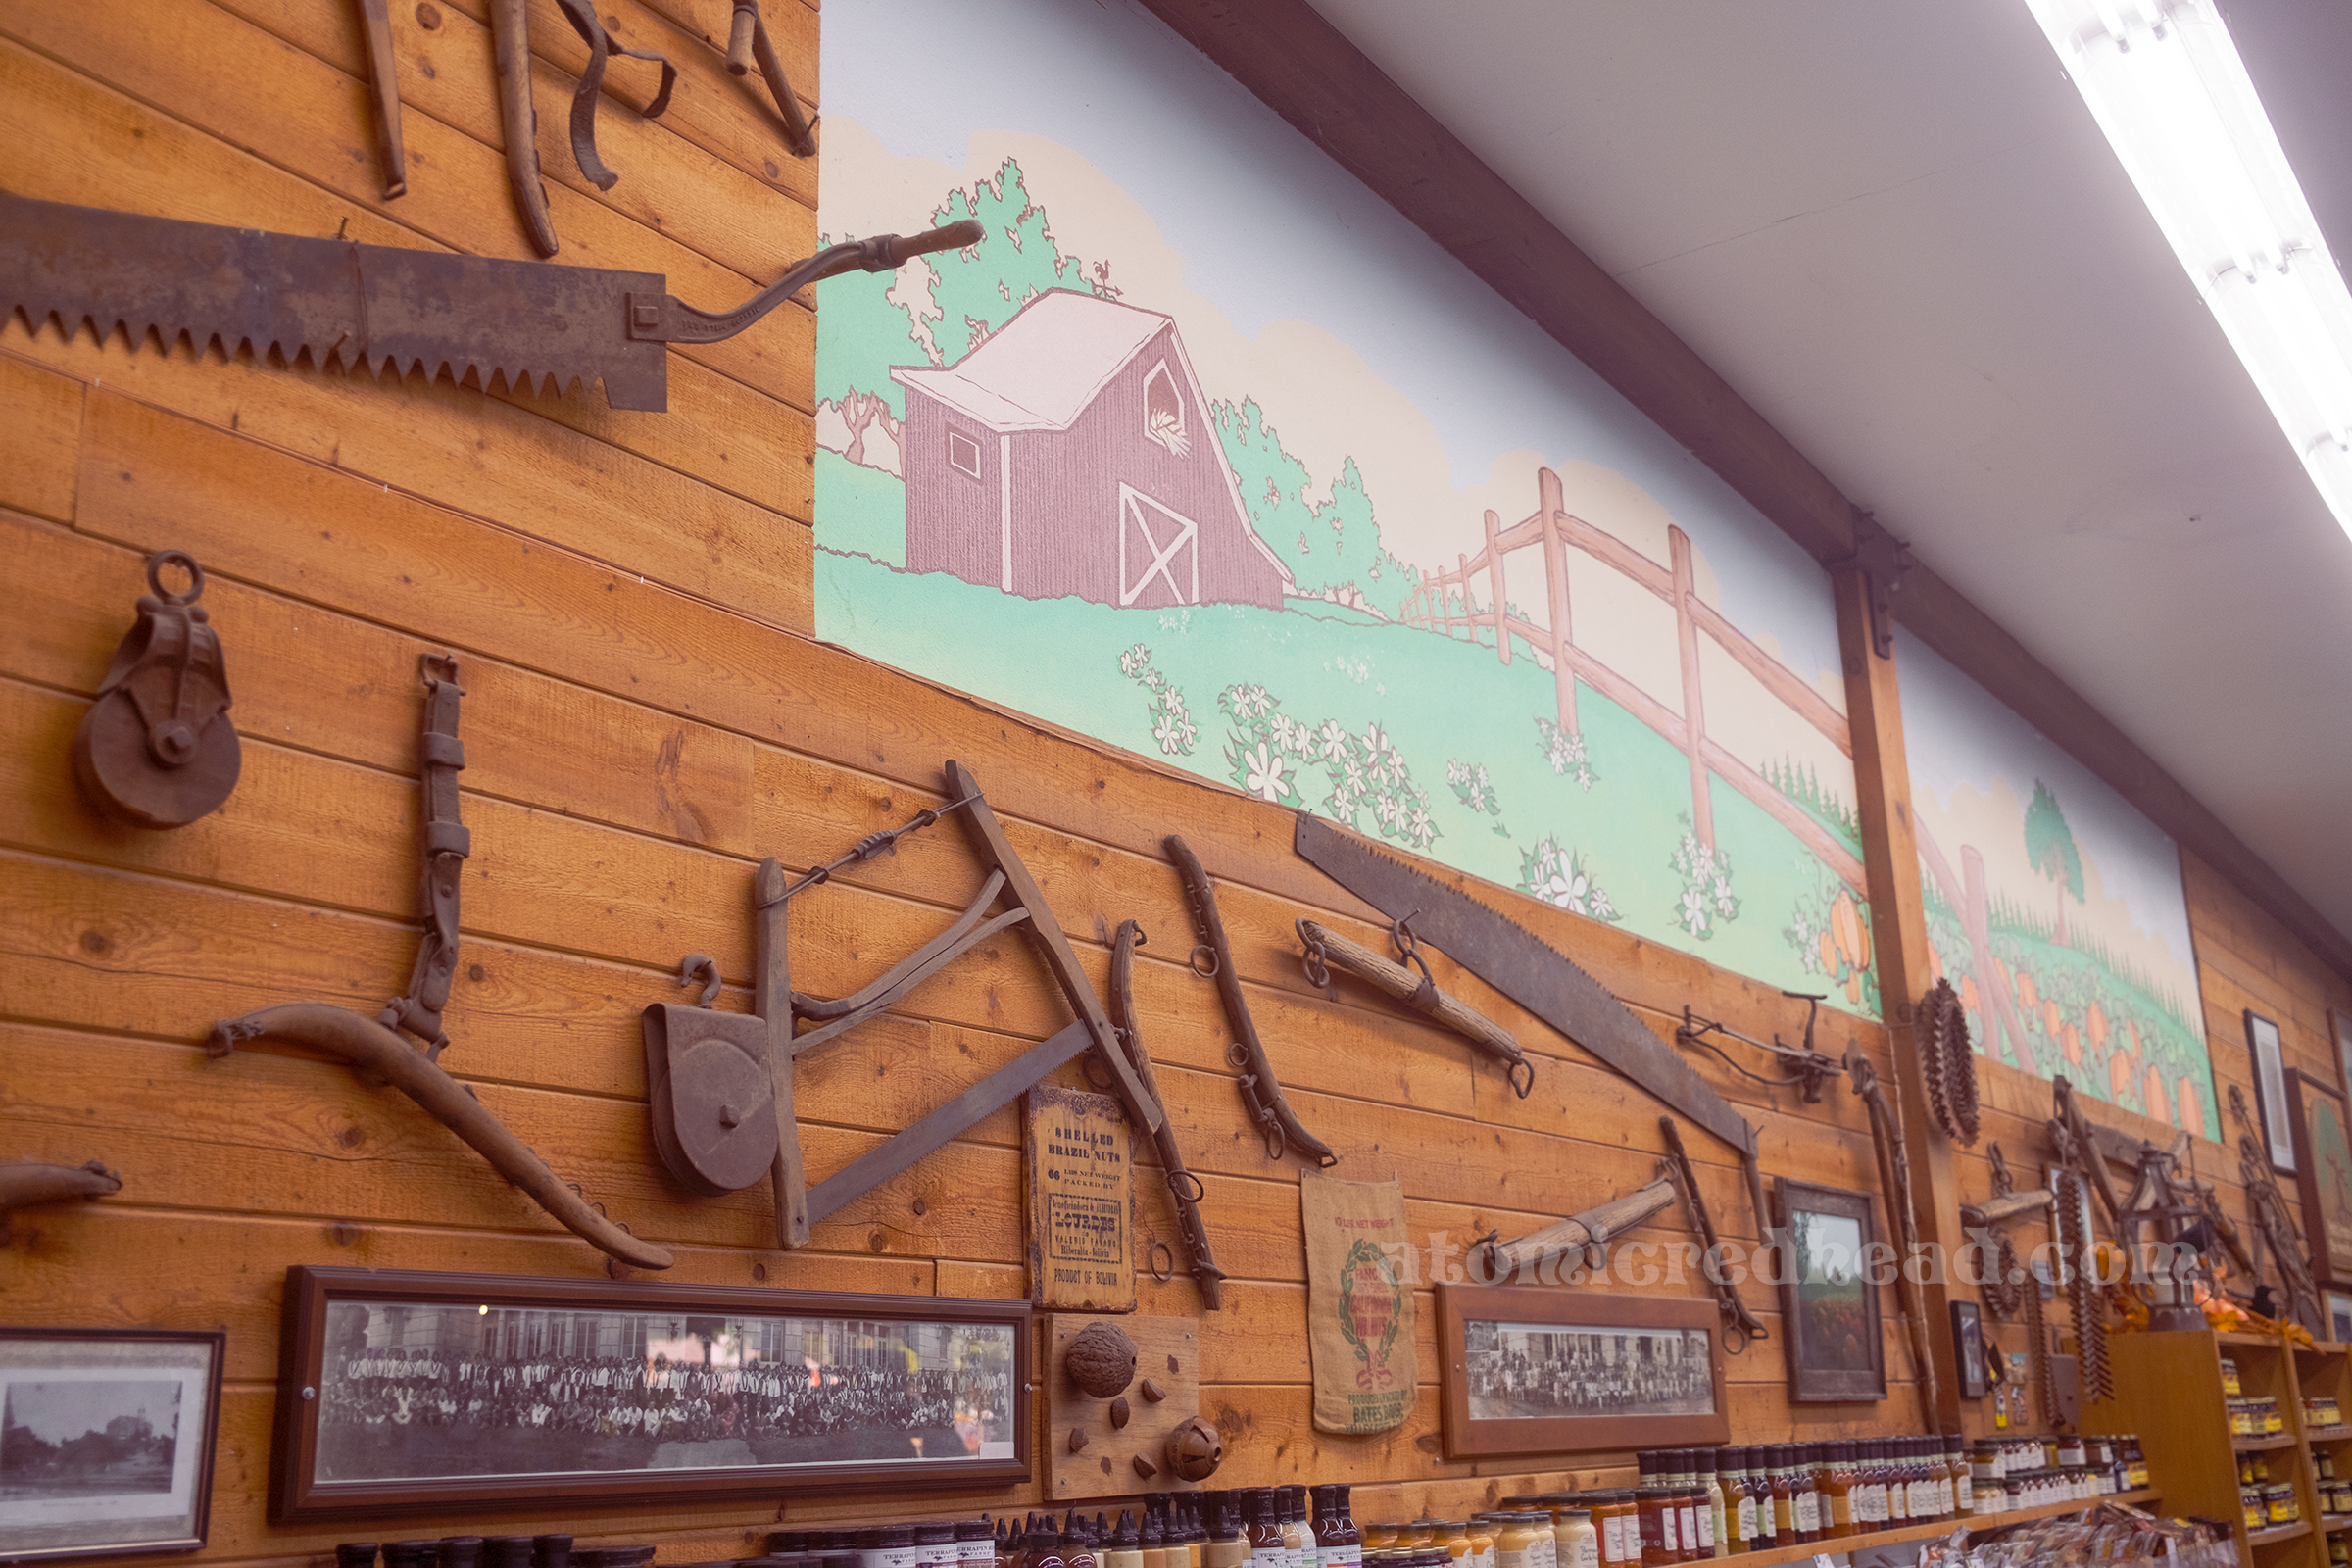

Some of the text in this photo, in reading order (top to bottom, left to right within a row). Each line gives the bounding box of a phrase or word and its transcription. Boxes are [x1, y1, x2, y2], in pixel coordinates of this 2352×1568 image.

[1055, 1127, 1114, 1146] SHELLED
[1048, 1144, 1121, 1163] BRAZIL NUTS
[1048, 1169, 1060, 1181] 66
[1064, 1178, 1101, 1188] PACKED
[1054, 1267, 1118, 1286] PRODUCT OF BOLIVIA
[1353, 1405, 1383, 1423] BATES
